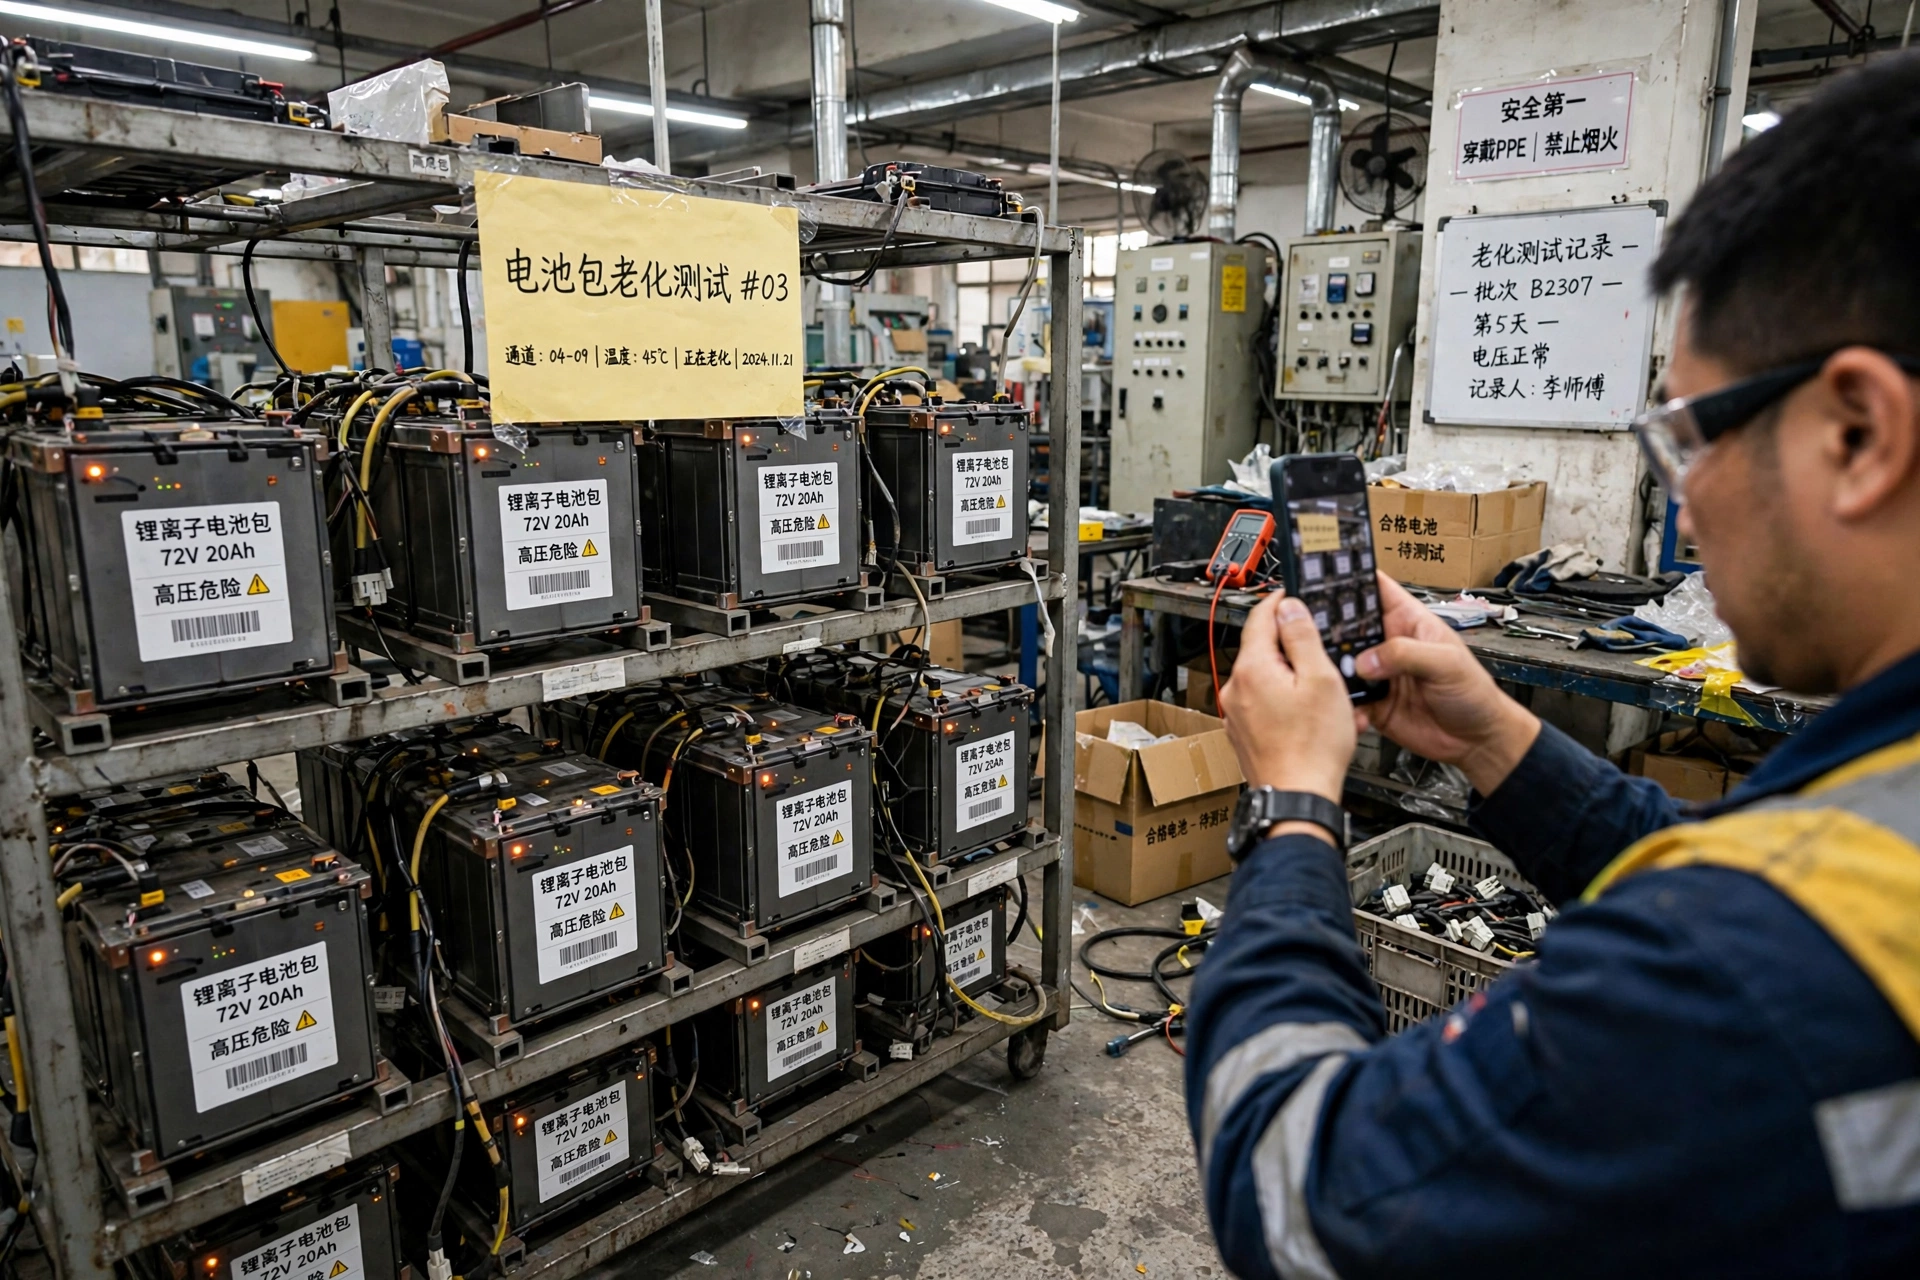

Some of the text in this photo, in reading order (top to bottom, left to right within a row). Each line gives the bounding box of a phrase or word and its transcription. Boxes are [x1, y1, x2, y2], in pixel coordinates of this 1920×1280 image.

[1501, 91, 1586, 123] 安全第一
[1462, 137, 1527, 164] 穿戴PPE
[1544, 125, 1618, 157] 禁止烟火
[1471, 233, 1613, 269] 老化测试记录
[505, 247, 789, 304] 电池包老化测试 #03
[1473, 279, 1519, 303] 批次
[1530, 275, 1593, 299] B2307
[1473, 311, 1529, 337] 第5天
[683, 347, 732, 367] 正在老化
[741, 351, 793, 367] 2024.11.21
[1473, 341, 1550, 369] 电压正常
[956, 456, 1009, 473] 锂离子电池包
[763, 469, 834, 490] 锂离子电池包
[982, 474, 1002, 487] 20Ah
[507, 488, 602, 512] 锂离子电池包
[775, 490, 824, 508] 72V 20Ah
[135, 512, 272, 542] 锂离子电池包
[523, 512, 589, 532] 72V 20Ah
[769, 515, 816, 535] 高压危险
[1378, 513, 1438, 536] 合格电池
[160, 541, 256, 566] 72V 20Ah
[517, 541, 579, 565] 高压危险
[1397, 540, 1445, 563] 待测试
[153, 577, 242, 607] 高压危险
[781, 788, 847, 820] 锂离子电池包
[792, 809, 839, 833] 72V 20Ah
[1145, 818, 1189, 846] 合格电池
[1199, 806, 1229, 831] 待测试
[787, 834, 831, 861] 高压危险
[540, 855, 628, 895] 锂离子电池包
[555, 880, 617, 910] 72V 20Ah
[549, 908, 607, 941] 高压危险
[193, 954, 319, 1008] 锂离子电池包
[216, 984, 304, 1023] 72V 20Ah
[771, 984, 832, 1021] 锂离子电池包
[800, 1004, 823, 1022] 20Ah
[208, 1018, 292, 1061] 高压危险
[541, 1089, 621, 1137] 锂离子电池包
[555, 1112, 611, 1146] 72V 20Ah
[550, 1136, 602, 1173] 高压危险
[240, 1215, 351, 1276] 锂离子电池包
[297, 1241, 337, 1269] 20Ah
